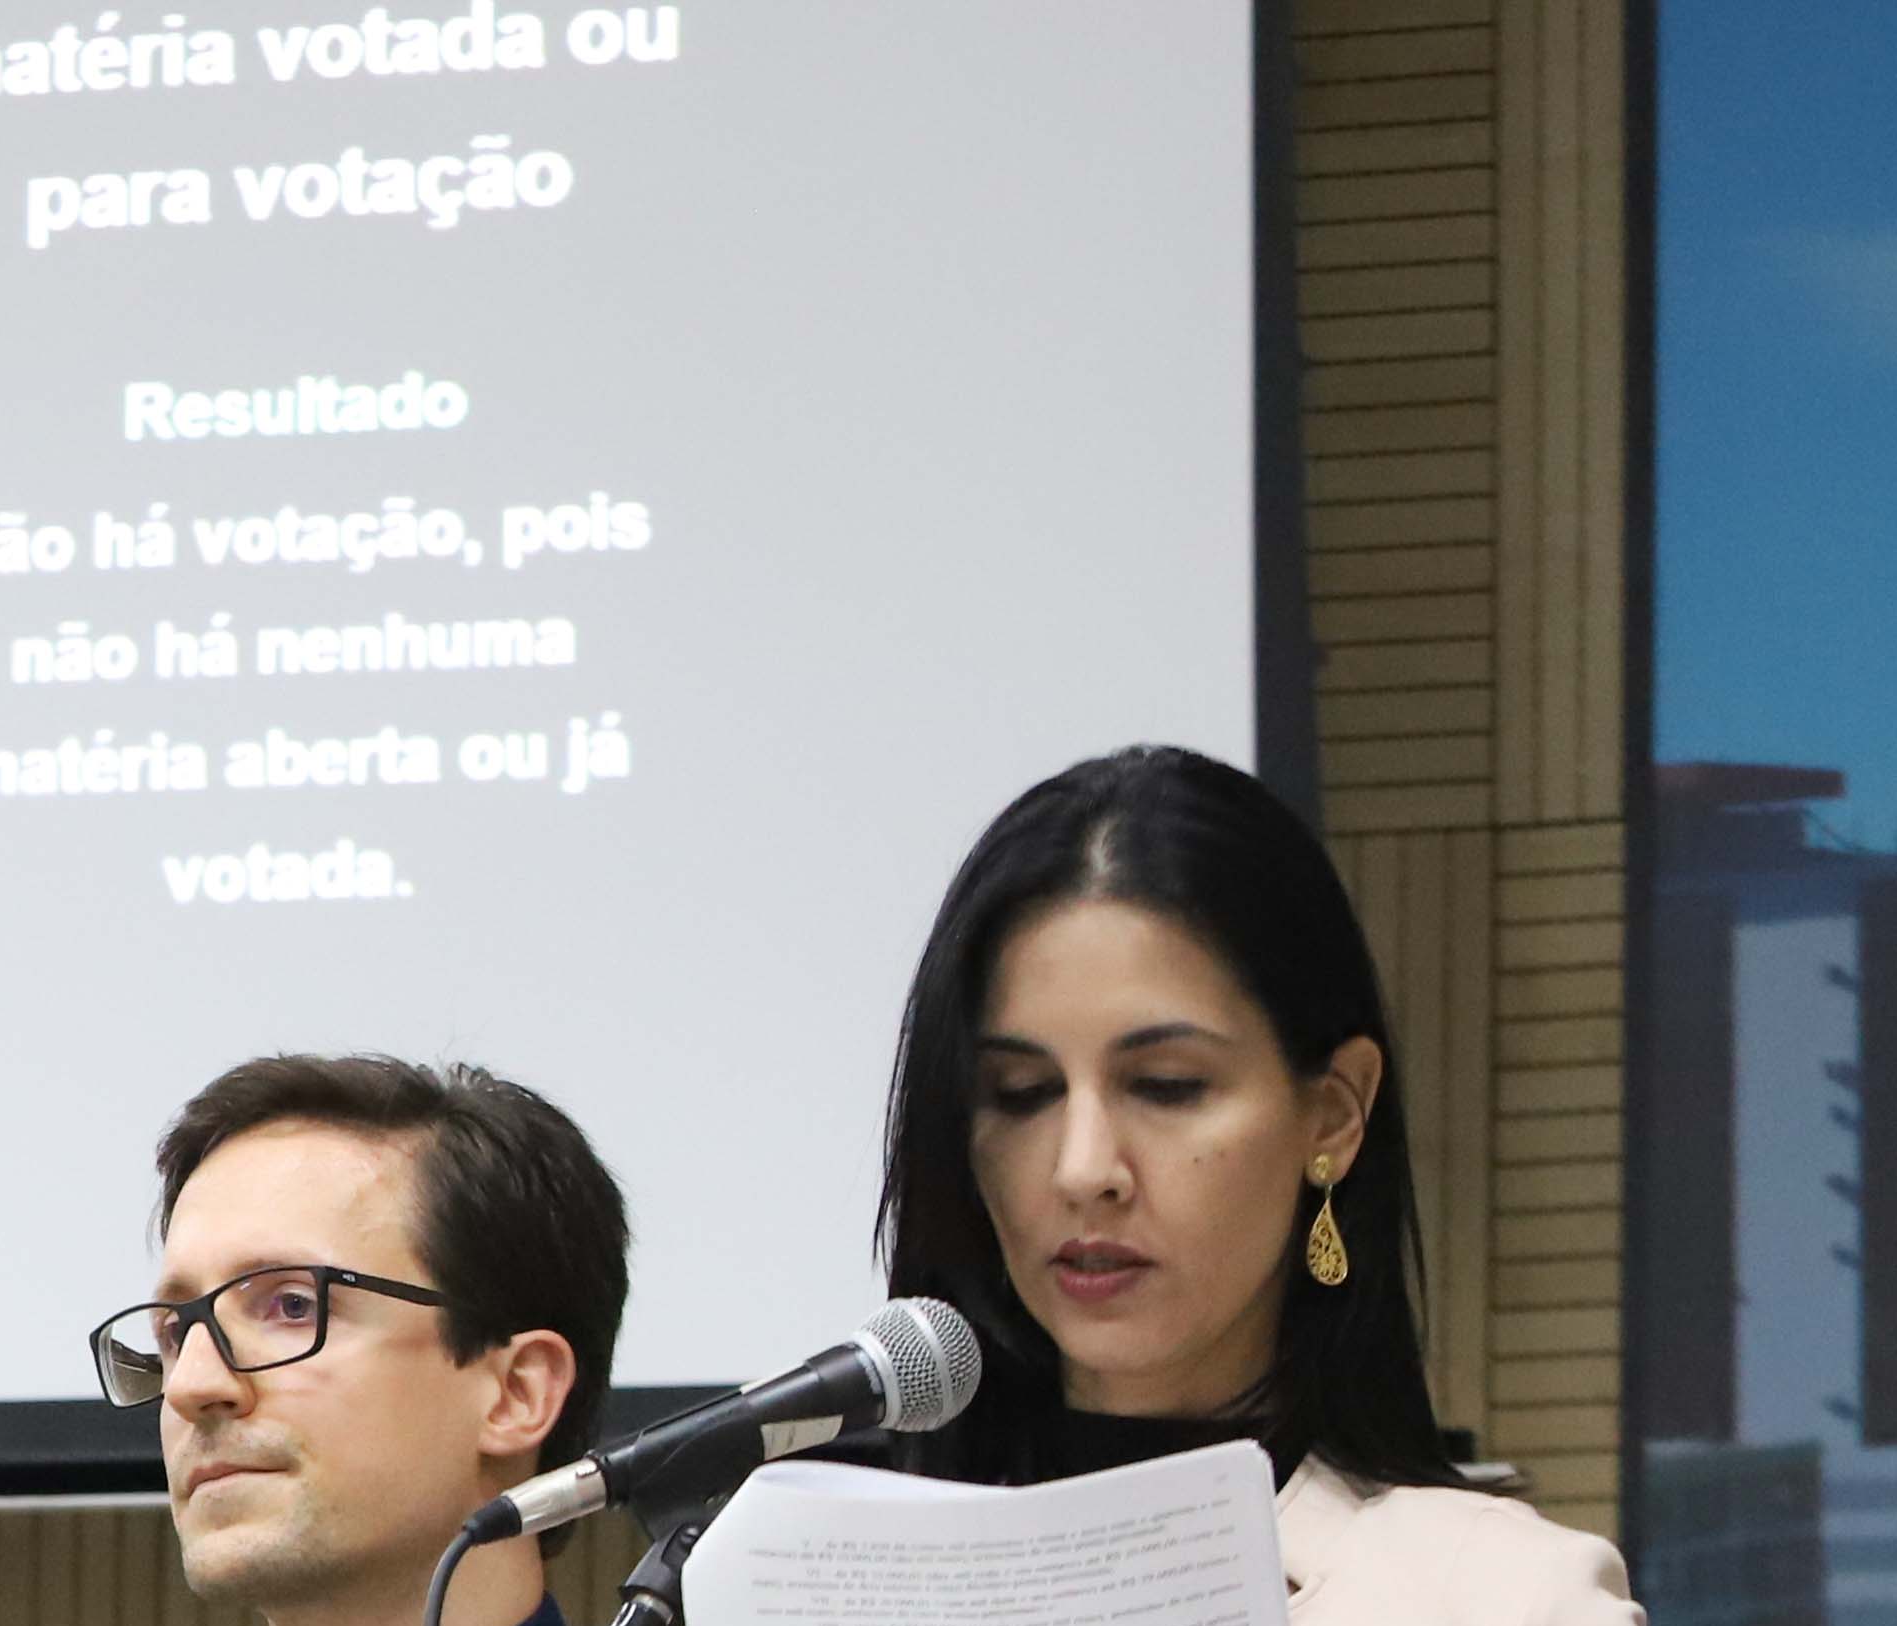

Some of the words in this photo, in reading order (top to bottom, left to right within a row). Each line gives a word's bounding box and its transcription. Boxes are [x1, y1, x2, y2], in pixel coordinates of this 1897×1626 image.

[257, 0, 546, 81] votada
[566, 6, 679, 65] ou
[27, 169, 213, 250] para
[233, 134, 574, 230] votação
[125, 371, 468, 440] Resultado
[93, 502, 176, 569] há
[193, 496, 483, 573] votação,
[503, 491, 651, 569] pois
[11, 621, 138, 683] não
[155, 612, 238, 678] há
[257, 612, 576, 675] nenhuma
[224, 726, 441, 788] aberta
[459, 733, 548, 781] ou
[561, 711, 629, 794] já
[162, 838, 413, 904] votada.
